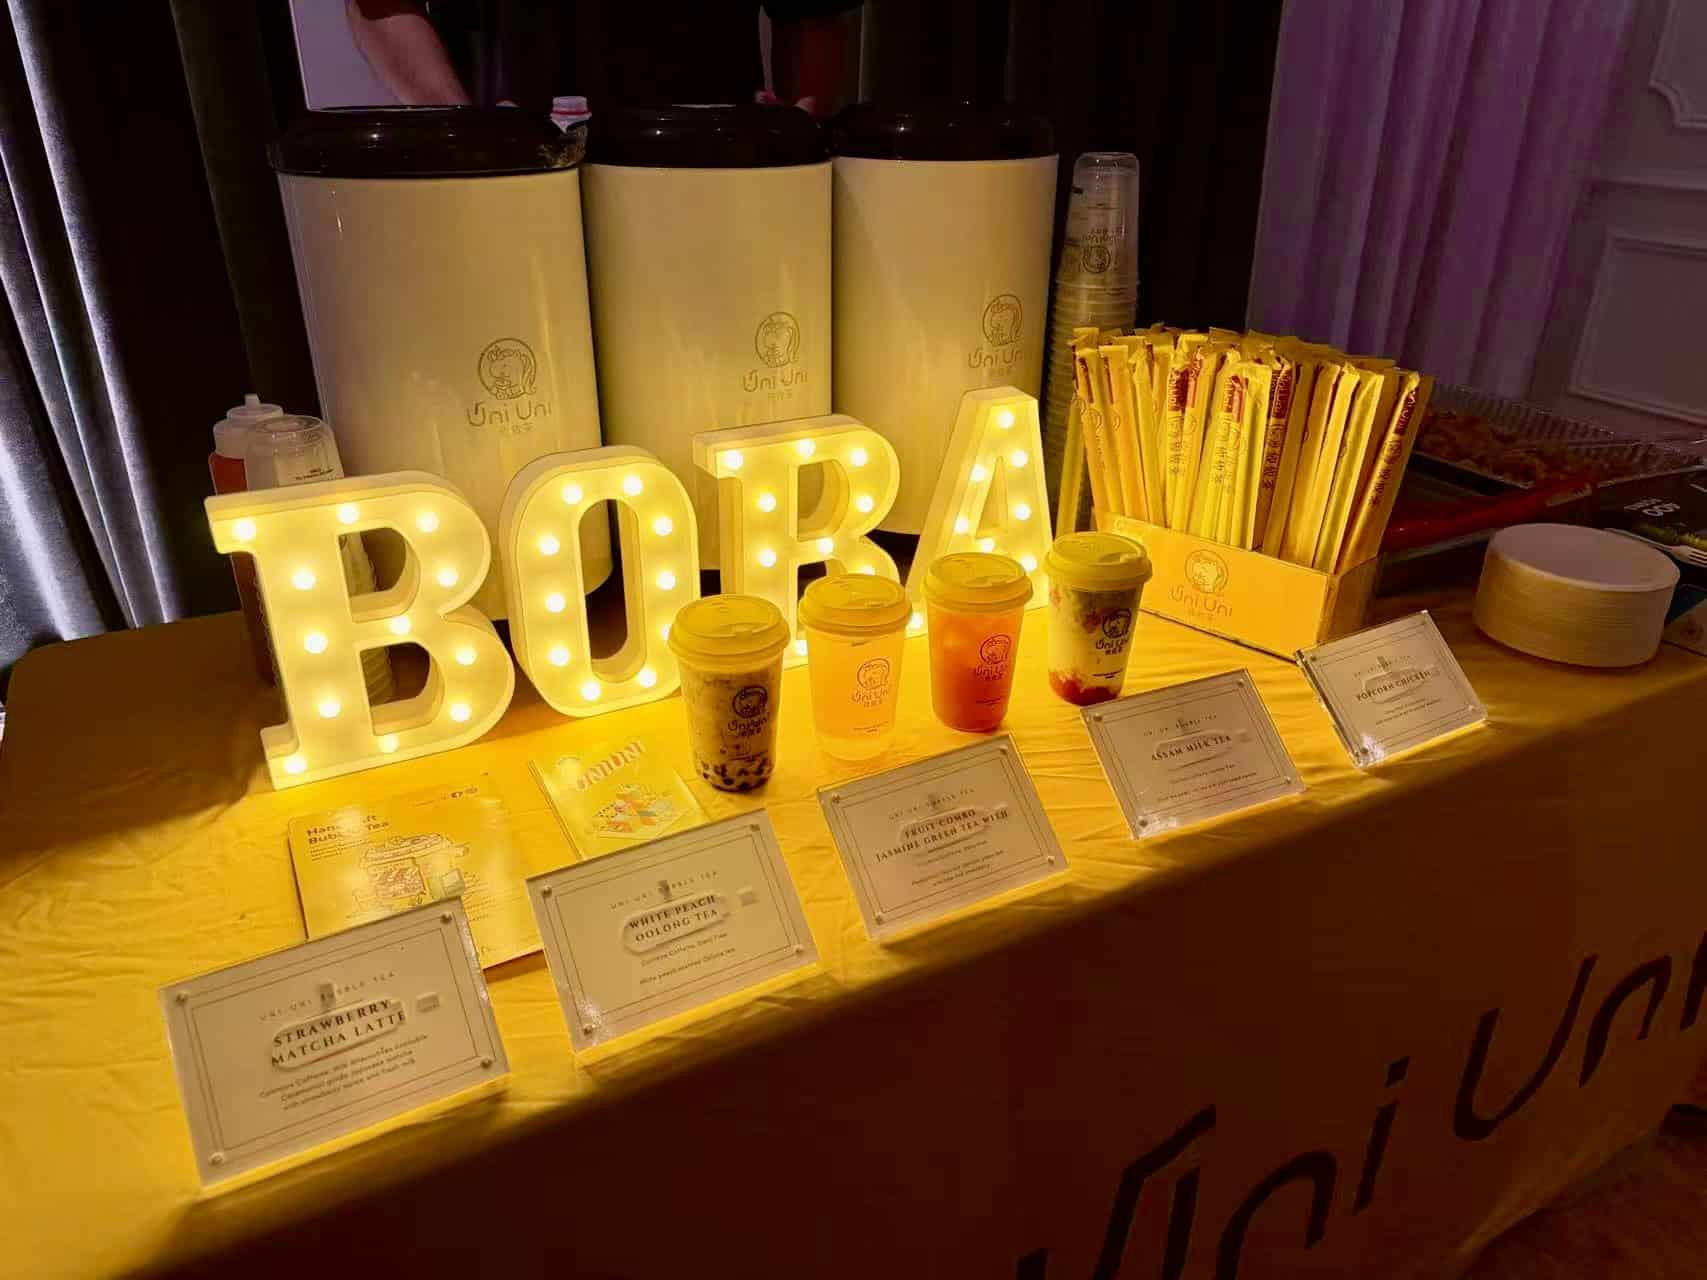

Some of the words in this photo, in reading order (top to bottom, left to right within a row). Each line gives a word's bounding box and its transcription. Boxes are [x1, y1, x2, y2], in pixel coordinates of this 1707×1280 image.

[466, 400, 509, 427] Uni
[515, 399, 552, 420] Uni
[205, 387, 1055, 790] BOBA
[1151, 747, 1184, 761] ASSAM
[1185, 739, 1210, 752] MILK
[1212, 735, 1232, 745] TEA
[876, 840, 919, 862] JASMINE
[923, 827, 957, 845] GREEN
[960, 820, 980, 832] TEA
[982, 809, 1008, 823] WITH
[904, 823, 936, 839] FRUIT
[938, 808, 976, 827] COMBO
[629, 910, 669, 929] WHITE
[675, 895, 716, 916] PEACH
[635, 917, 691, 942] OOLONG
[695, 909, 718, 921] TEA
[271, 1032, 348, 1069] MATCHA
[353, 1010, 407, 1038] LATTE
[272, 998, 392, 1049] STRAWBERRY
